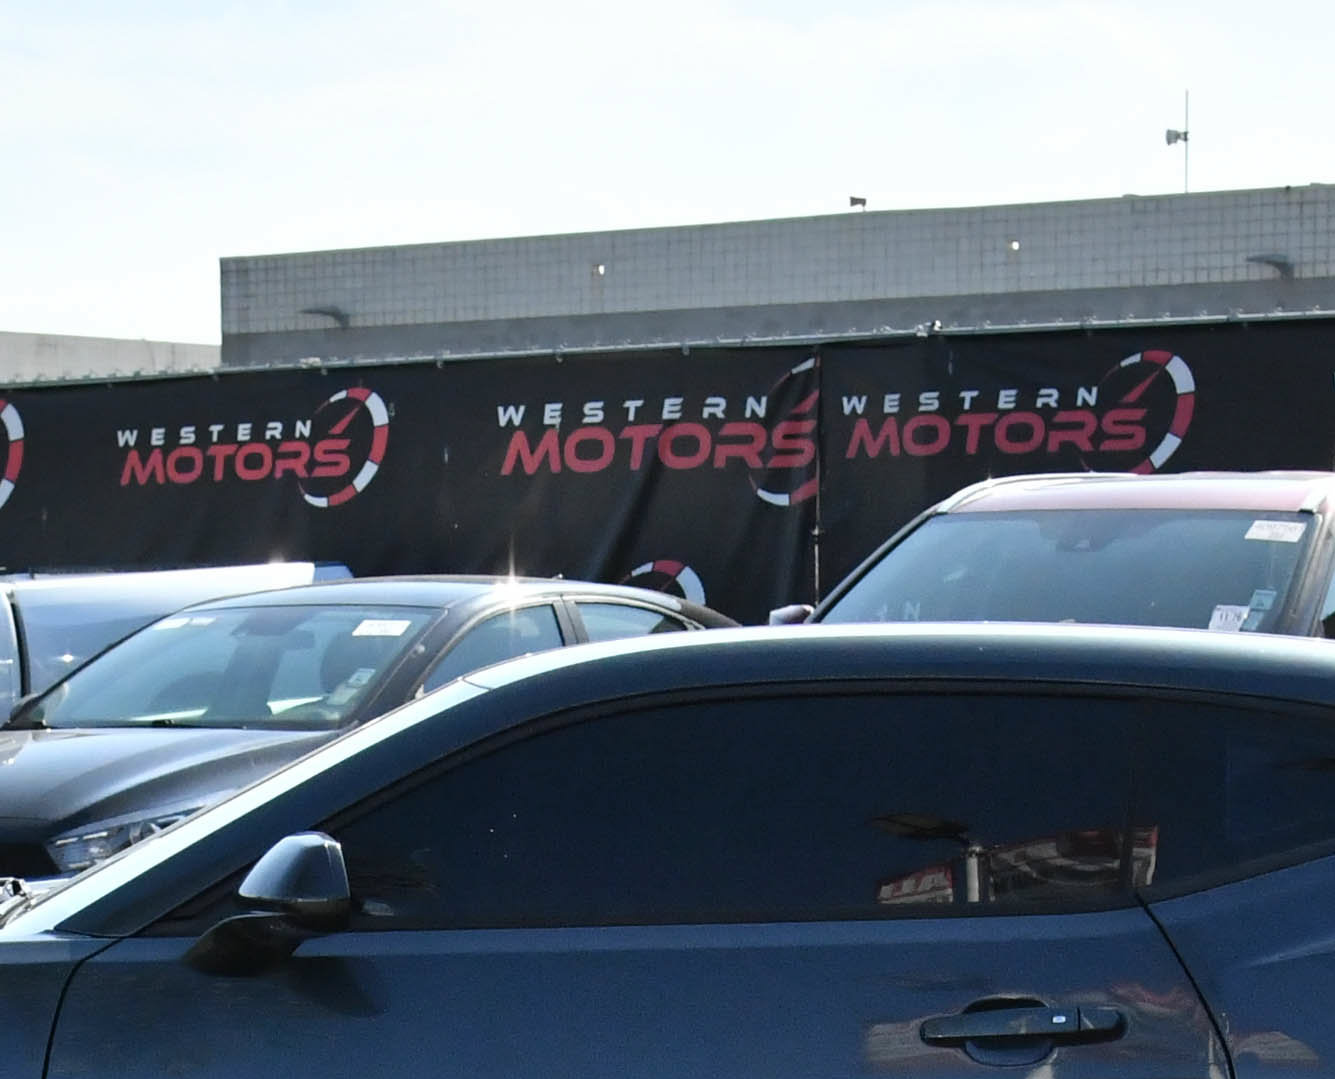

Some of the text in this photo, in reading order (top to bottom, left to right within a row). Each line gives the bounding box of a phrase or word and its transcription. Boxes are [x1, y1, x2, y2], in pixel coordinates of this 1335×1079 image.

[496, 396, 768, 428] WESTERN
[841, 386, 1099, 416] WESTERN
[116, 419, 313, 448] WESTERN
[500, 419, 817, 476] MOTORS
[845, 408, 1148, 459] MOTORS
[120, 438, 352, 487] MOTORS
